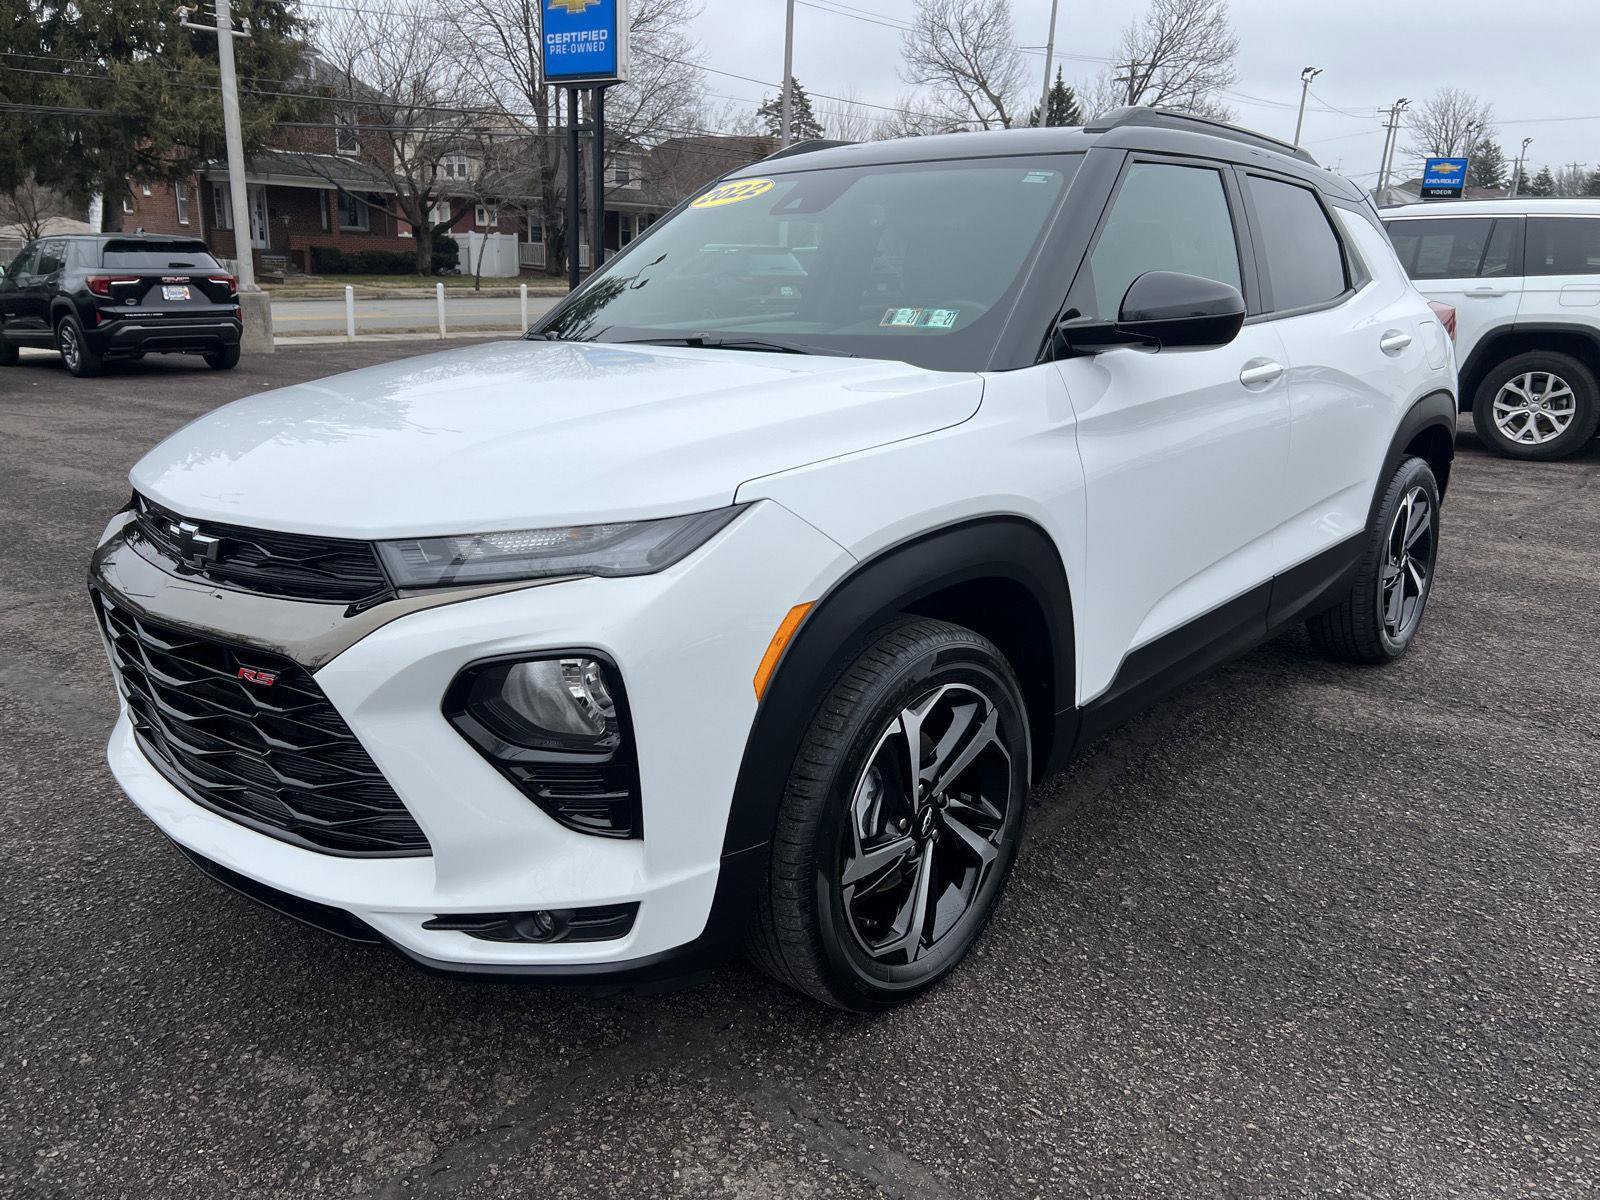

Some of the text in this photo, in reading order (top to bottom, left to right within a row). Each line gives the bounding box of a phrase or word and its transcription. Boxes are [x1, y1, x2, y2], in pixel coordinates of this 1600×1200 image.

[547, 29, 608, 44] CERTIFIED
[549, 41, 605, 55] PRE-OWNED
[238, 667, 276, 686] RS
